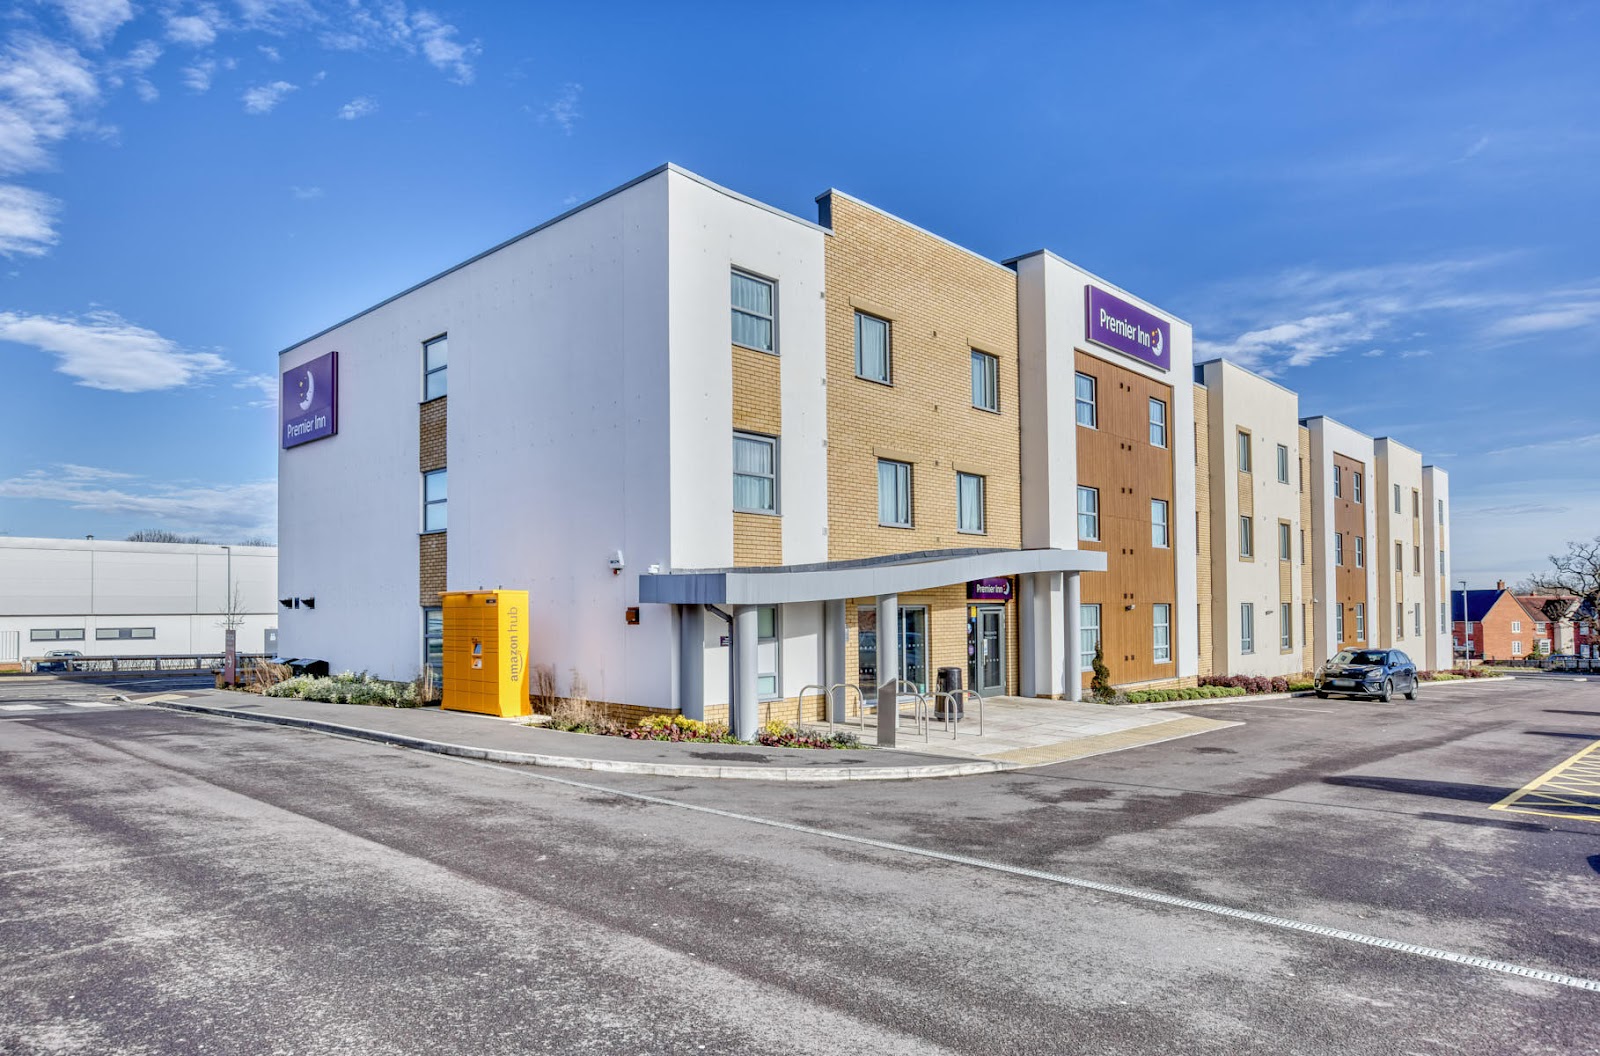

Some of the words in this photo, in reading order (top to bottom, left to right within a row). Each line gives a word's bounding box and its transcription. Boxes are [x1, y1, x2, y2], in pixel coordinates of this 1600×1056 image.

[1100, 308, 1136, 340] Premier
[1137, 325, 1150, 347] Inn
[287, 419, 314, 438] Premier
[314, 415, 326, 430] Inn
[976, 583, 995, 593] Premier
[995, 585, 1003, 593] Inn
[507, 606, 518, 632] hub
[510, 636, 519, 682] amazon
